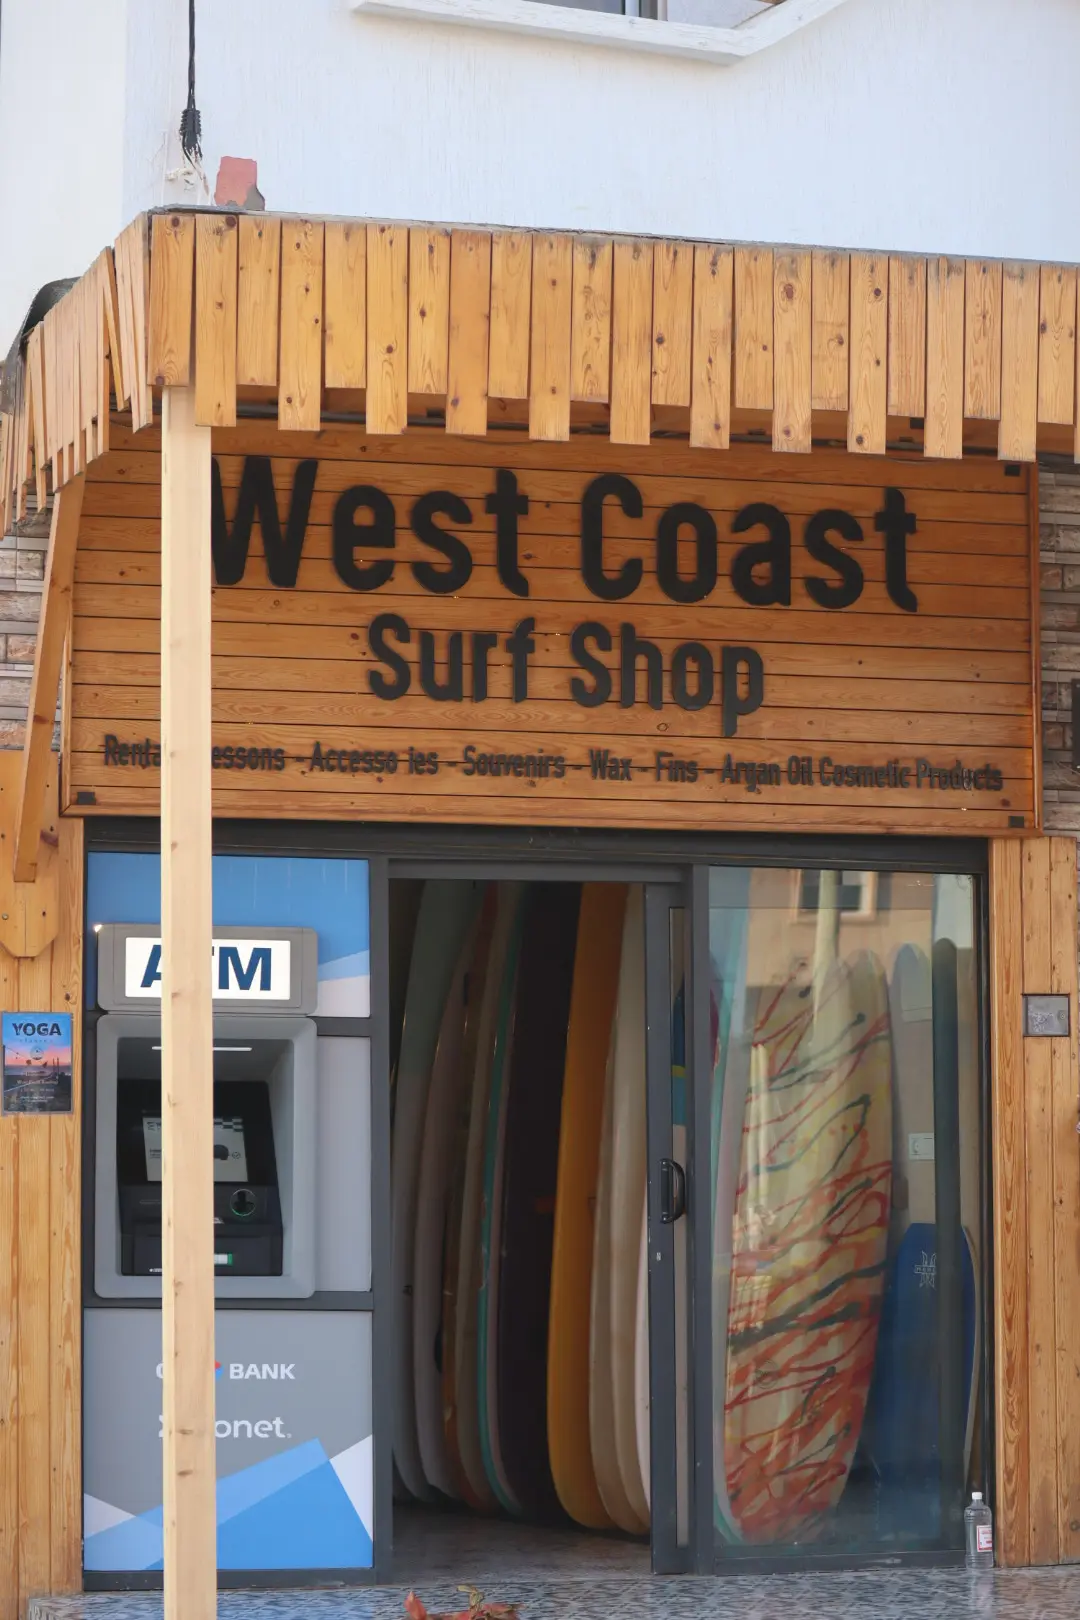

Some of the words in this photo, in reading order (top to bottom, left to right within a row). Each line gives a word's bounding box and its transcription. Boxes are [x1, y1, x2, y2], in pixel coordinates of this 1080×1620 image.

[211, 455, 530, 597] West
[581, 474, 918, 612] Coast
[367, 612, 536, 704] Surf
[570, 621, 764, 738] Shop
[104, 734, 161, 767] Renta
[211, 745, 285, 770] essons
[463, 745, 566, 778] Souvenirs
[590, 749, 633, 781] Wax
[655, 751, 699, 783] Fins
[721, 753, 781, 792] Argan
[787, 755, 813, 786] Oil
[819, 755, 911, 788] Cosmetic
[916, 757, 1004, 791] Products
[140, 944, 272, 991] AM
[12, 1022, 62, 1037] YOGA
[229, 1363, 296, 1380] BANK
